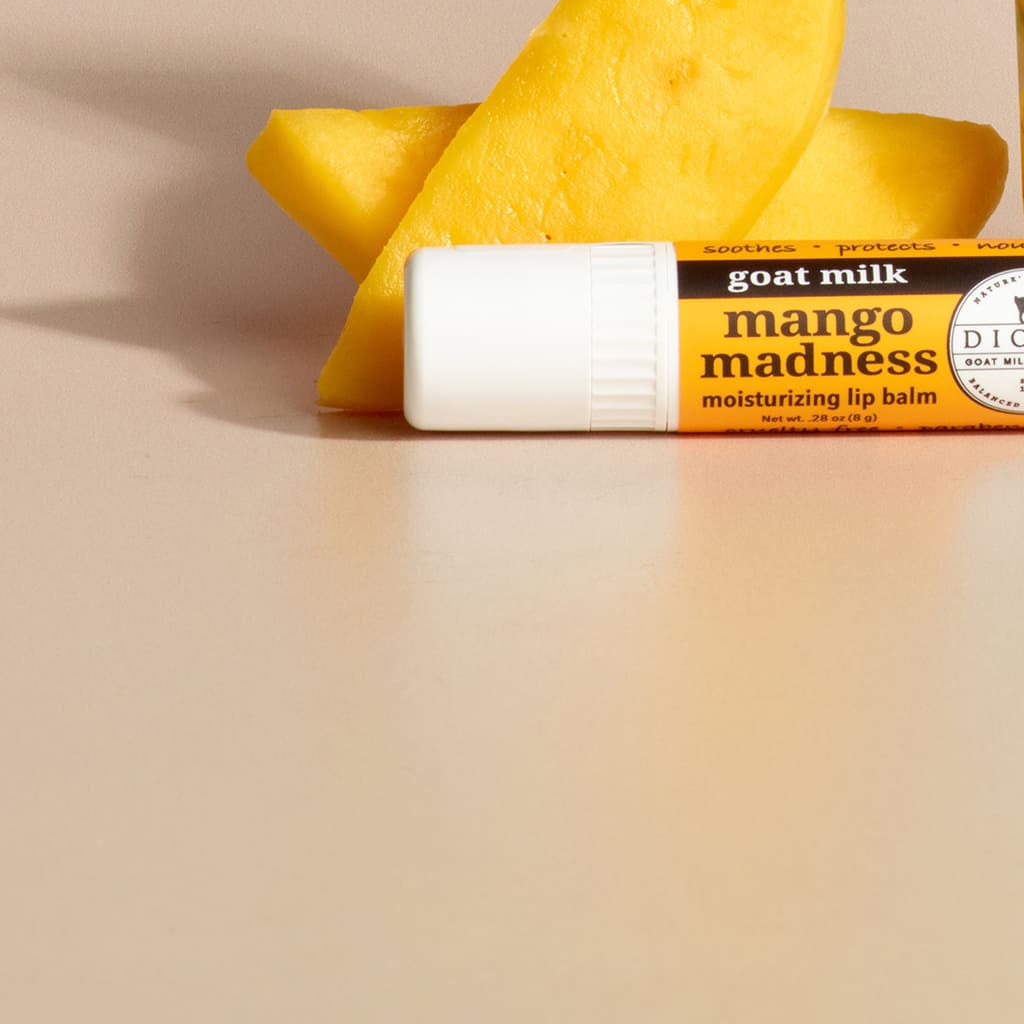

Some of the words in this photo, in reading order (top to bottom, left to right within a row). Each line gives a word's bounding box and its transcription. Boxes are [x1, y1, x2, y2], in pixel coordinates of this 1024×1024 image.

[703, 243, 797, 254] soothes
[835, 242, 936, 256] protects
[727, 266, 810, 293] goat
[820, 264, 908, 285] milk
[723, 306, 913, 347] mango
[700, 342, 938, 379] madness
[965, 357, 997, 366] GOAT
[702, 390, 840, 410] moisturizing
[847, 388, 875, 409] lip
[882, 387, 938, 405] balm
[968, 377, 1021, 408] BALANCED
[762, 414, 783, 423] Net
[786, 414, 804, 423] wt.
[832, 415, 846, 423] oz
[847, 413, 862, 423] (8
[863, 413, 878, 423] g)
